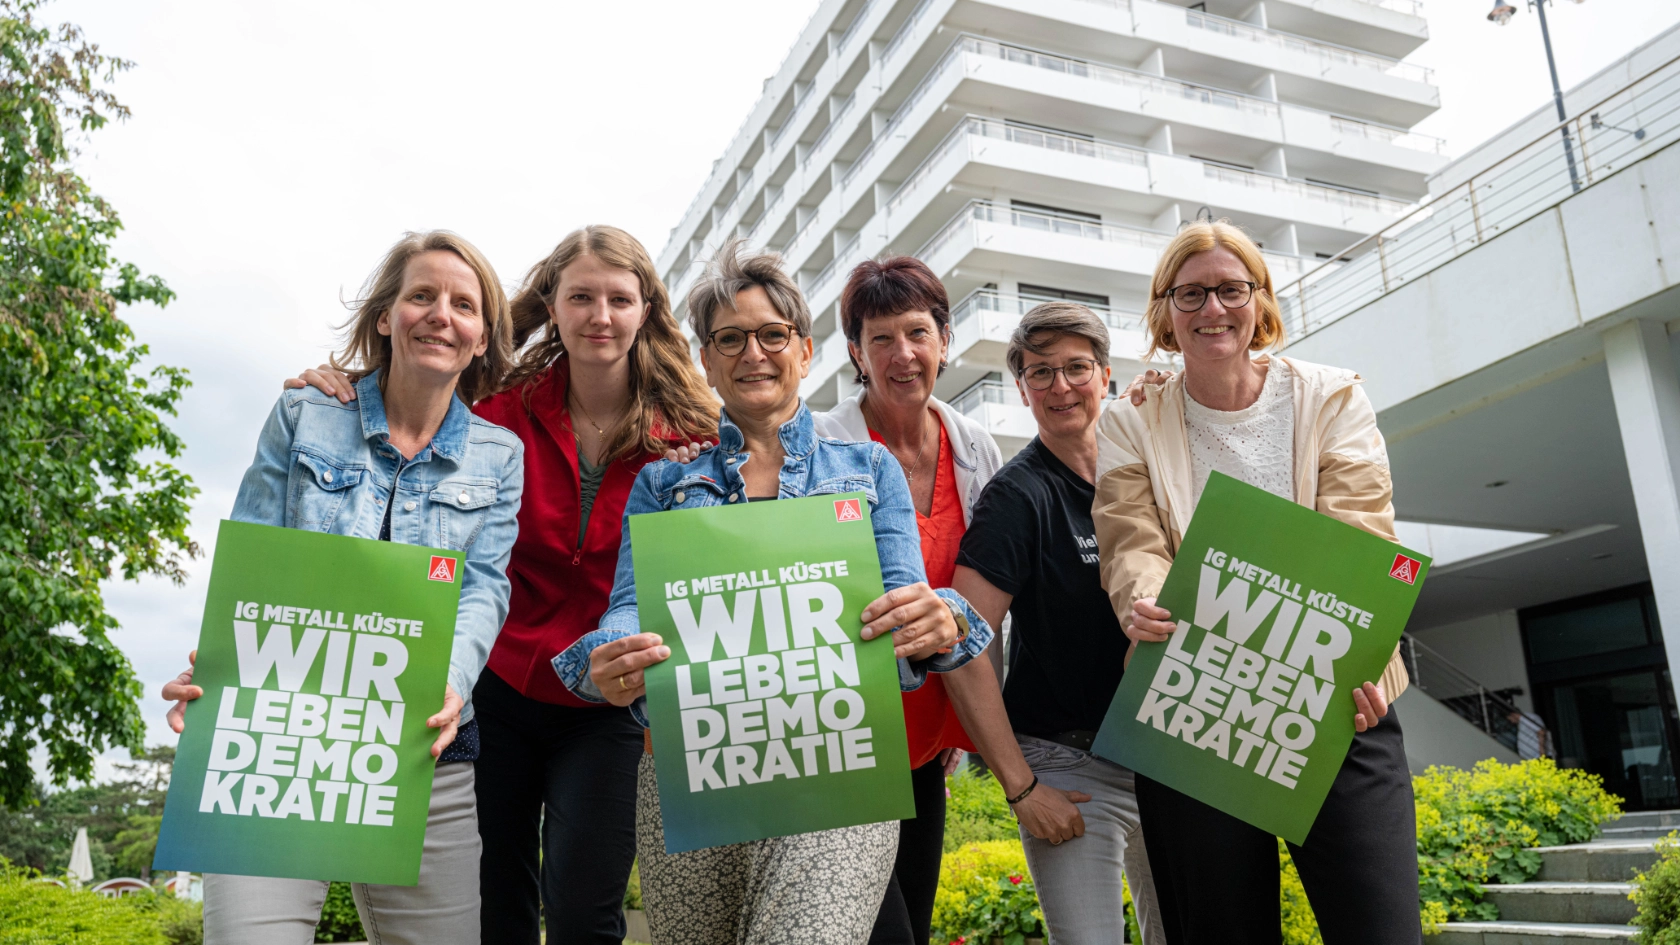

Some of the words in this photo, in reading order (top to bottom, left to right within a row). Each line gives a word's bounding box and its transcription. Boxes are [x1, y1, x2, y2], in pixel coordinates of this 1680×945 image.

[664, 582, 687, 599] IG
[692, 569, 776, 596] METALL
[779, 560, 849, 584] KÜSTE
[1080, 553, 1100, 564] un
[1203, 547, 1227, 569] IG
[1227, 556, 1303, 602] METALL
[1305, 588, 1374, 630] KÜSTE
[234, 600, 259, 620] IG
[262, 604, 349, 630] METALL
[352, 612, 424, 638] KÜSTE
[666, 581, 851, 664] WIR
[1193, 563, 1352, 684] WIR
[233, 620, 409, 702] WIR
[675, 643, 861, 710] LEBEN
[1164, 619, 1336, 722] LEBEN
[215, 686, 406, 745] LEBEN
[680, 688, 866, 752] DEMO
[1149, 655, 1316, 751] DEMO
[207, 729, 399, 785] DEMO
[685, 727, 877, 793] KRATIE
[1135, 688, 1308, 790] KRATIE
[198, 770, 398, 827] KRATIE
